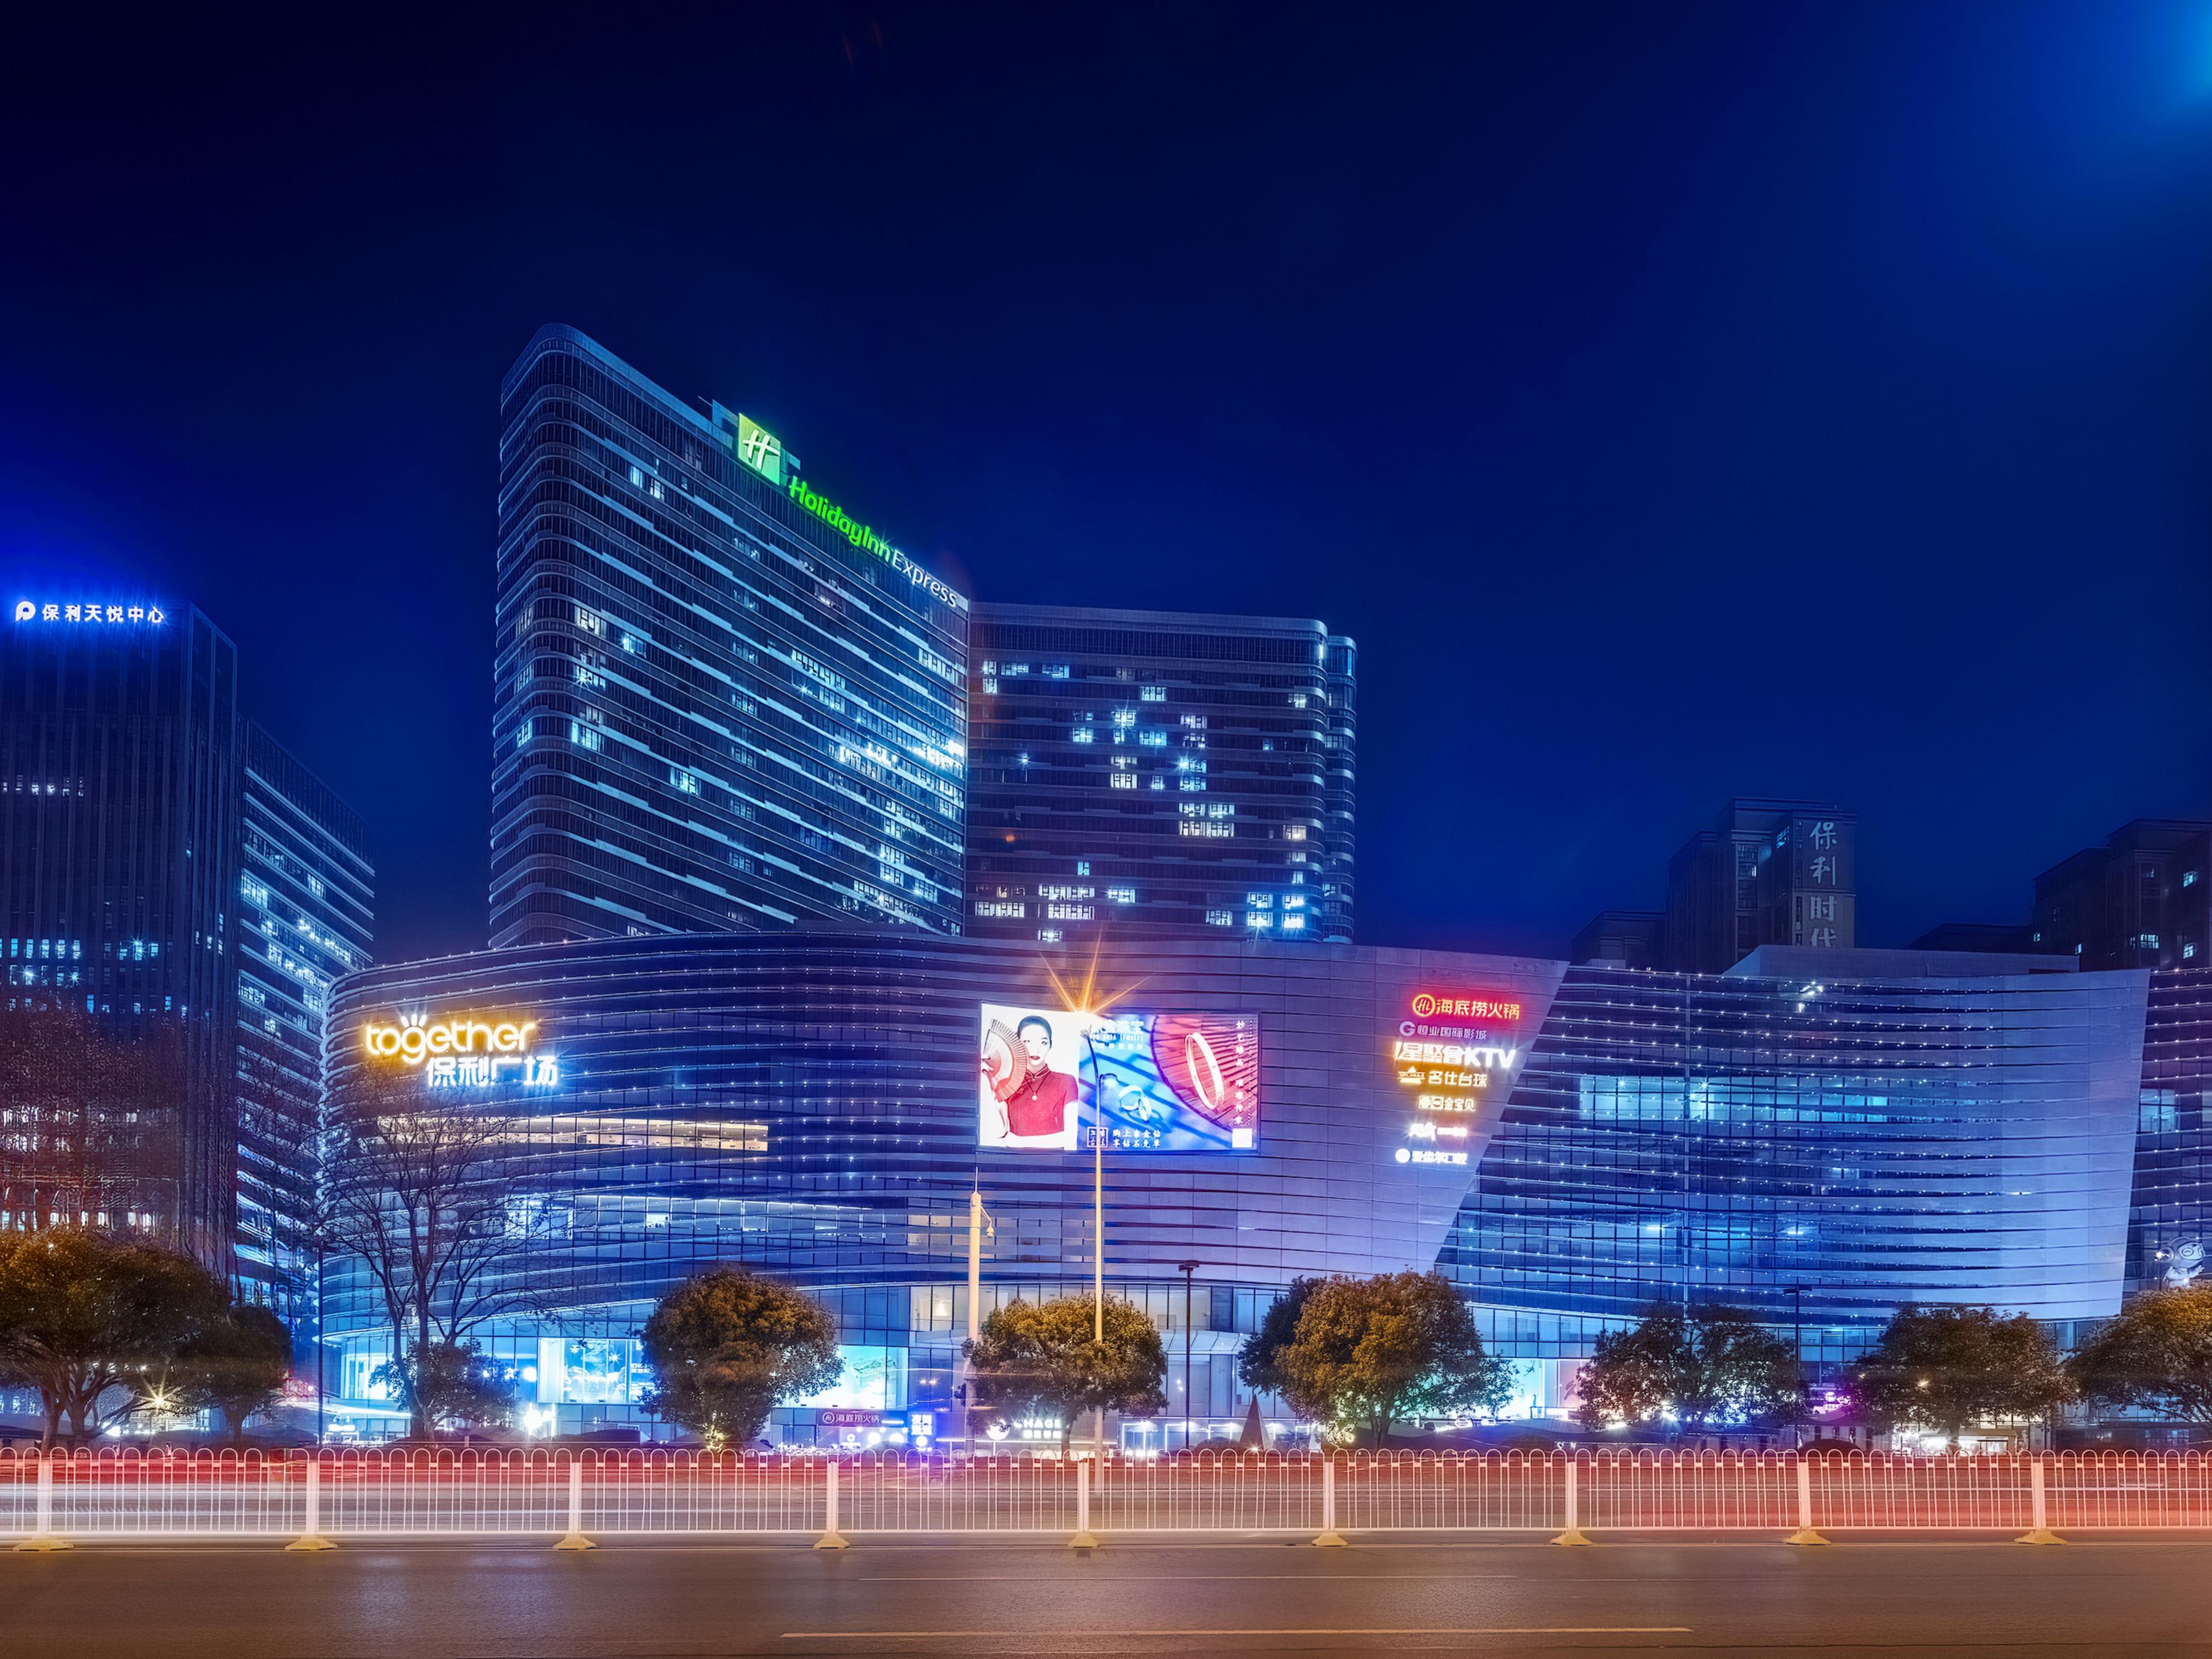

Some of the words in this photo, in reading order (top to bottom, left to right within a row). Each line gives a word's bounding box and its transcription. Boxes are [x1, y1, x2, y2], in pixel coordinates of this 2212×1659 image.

[892, 549, 958, 608] Express
[41, 604, 165, 623] 保利天悦中心
[1809, 822, 1837, 947] 保利时代
[1436, 999, 1521, 1020] 海底捞火锅
[366, 1020, 536, 1065] together
[1417, 1025, 1488, 1040] 恒业国际影城
[426, 1056, 559, 1087] 保利广场
[1428, 1071, 1488, 1088] 名仕台球
[1443, 1097, 1476, 1112] 金宝贝
